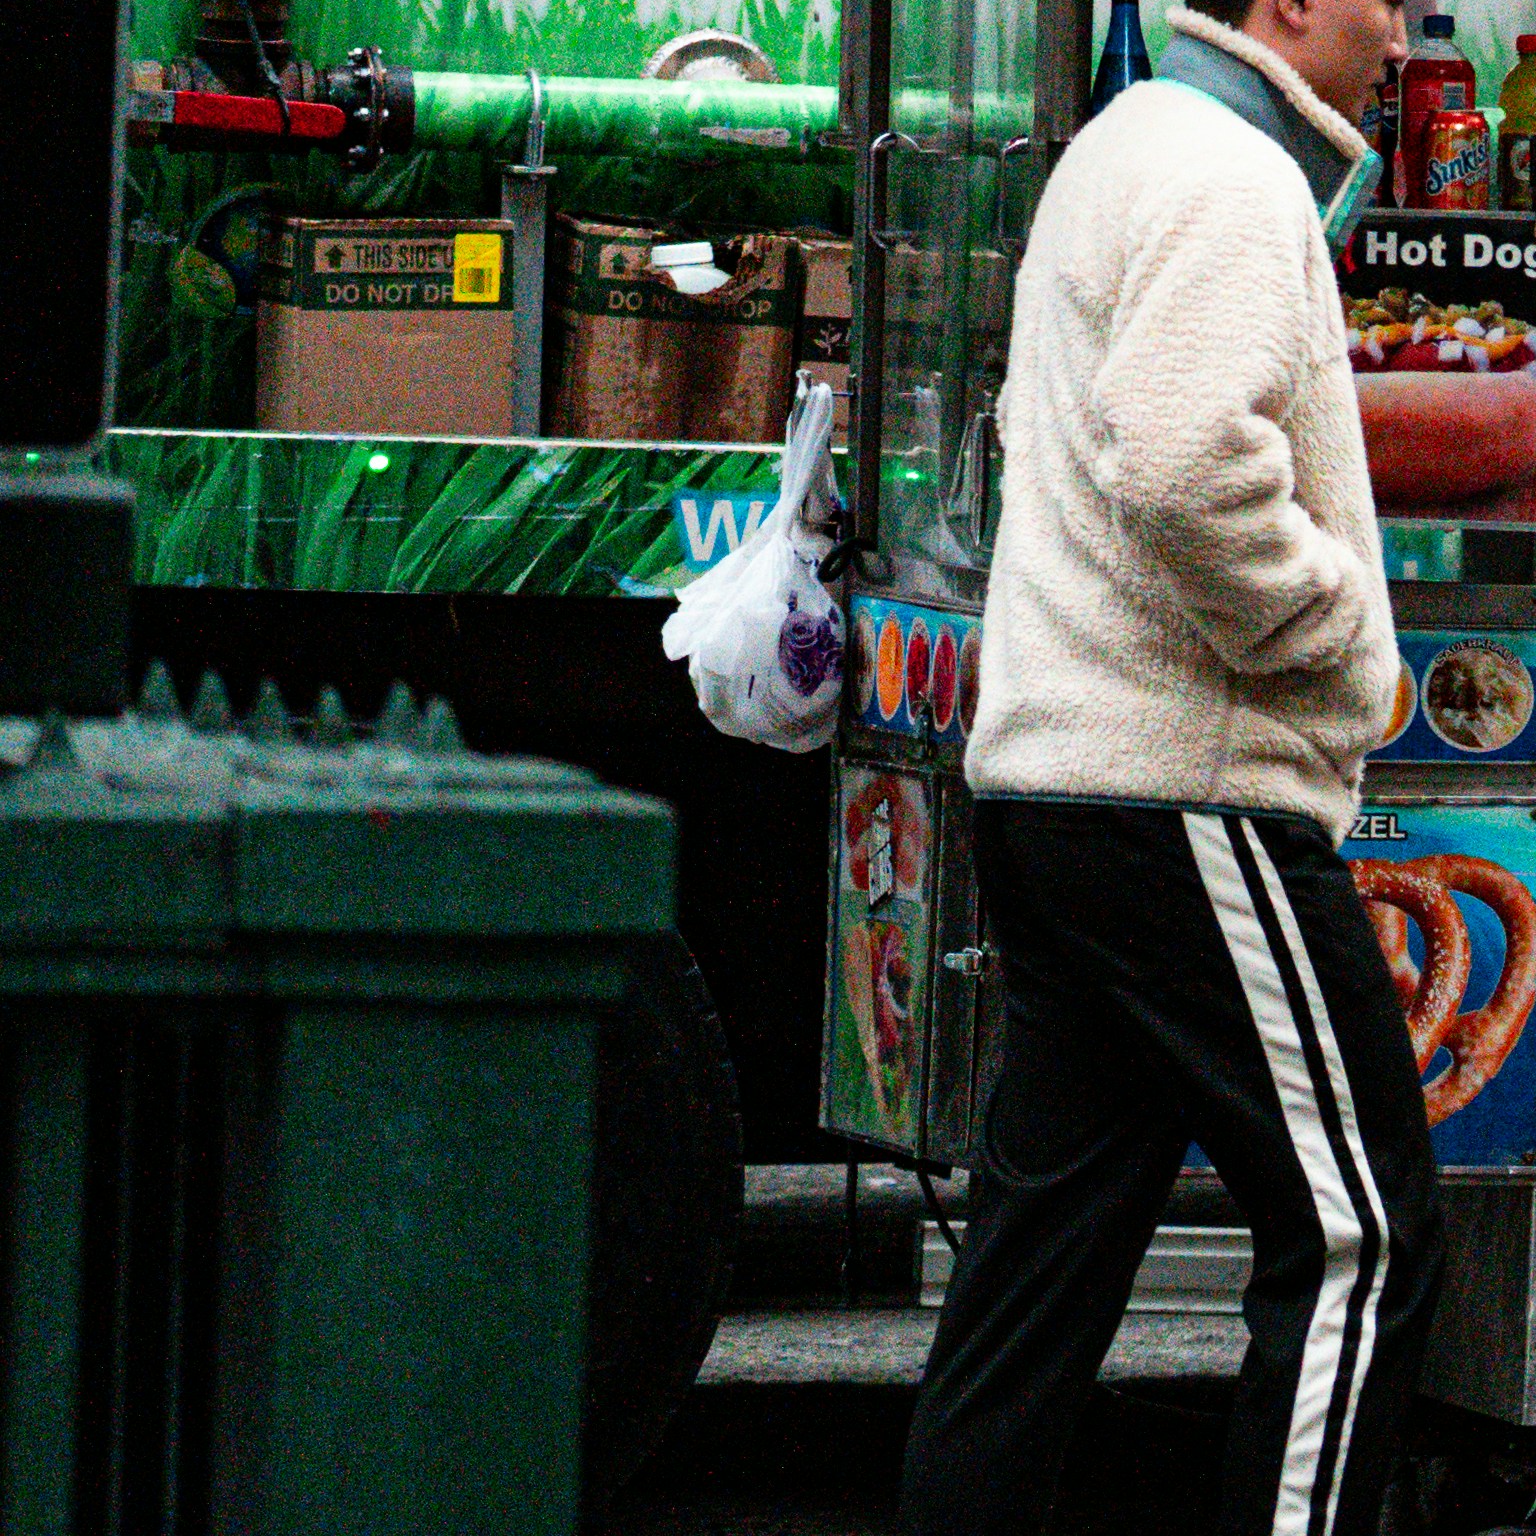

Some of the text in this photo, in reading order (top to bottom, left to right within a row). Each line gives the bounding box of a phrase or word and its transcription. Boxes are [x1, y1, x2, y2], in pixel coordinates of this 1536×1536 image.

[353, 243, 436, 268] THIS SIDE
[1365, 230, 1447, 267] Hot
[325, 283, 416, 306] DO NOT
[606, 289, 643, 312] DO
